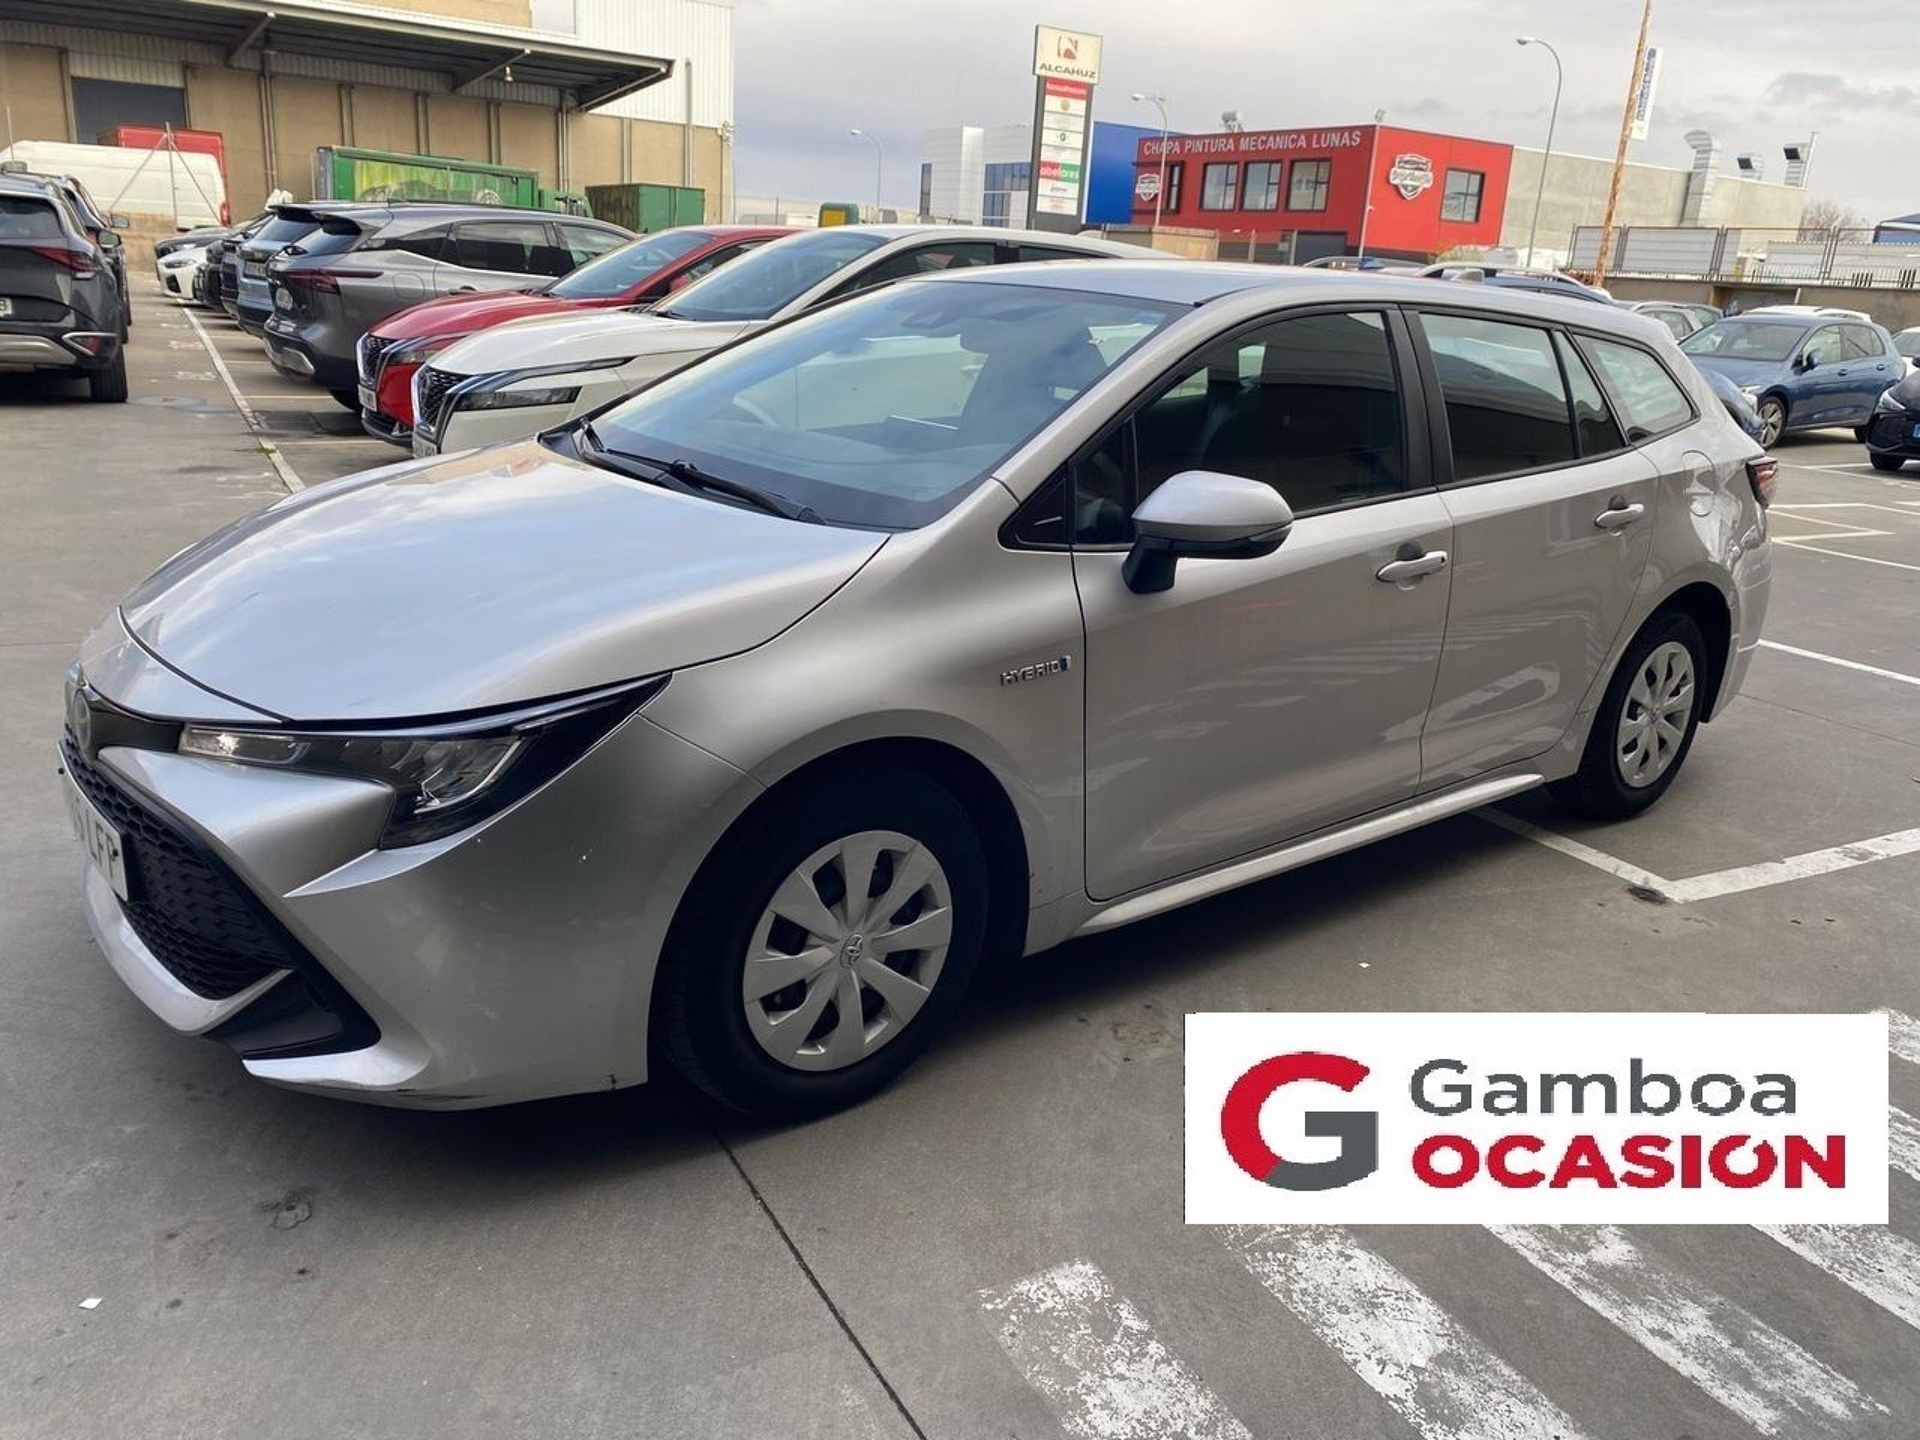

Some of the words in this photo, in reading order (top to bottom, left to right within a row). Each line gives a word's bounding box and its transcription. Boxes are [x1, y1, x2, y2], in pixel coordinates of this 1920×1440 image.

[1039, 62, 1096, 79] ALCAHUZ
[1143, 140, 1181, 156] CHAPA
[1185, 136, 1235, 154] PINTURA
[1239, 132, 1307, 151] MECANICA
[1312, 130, 1362, 149] LUNAS
[1000, 660, 1059, 685] HYBRID
